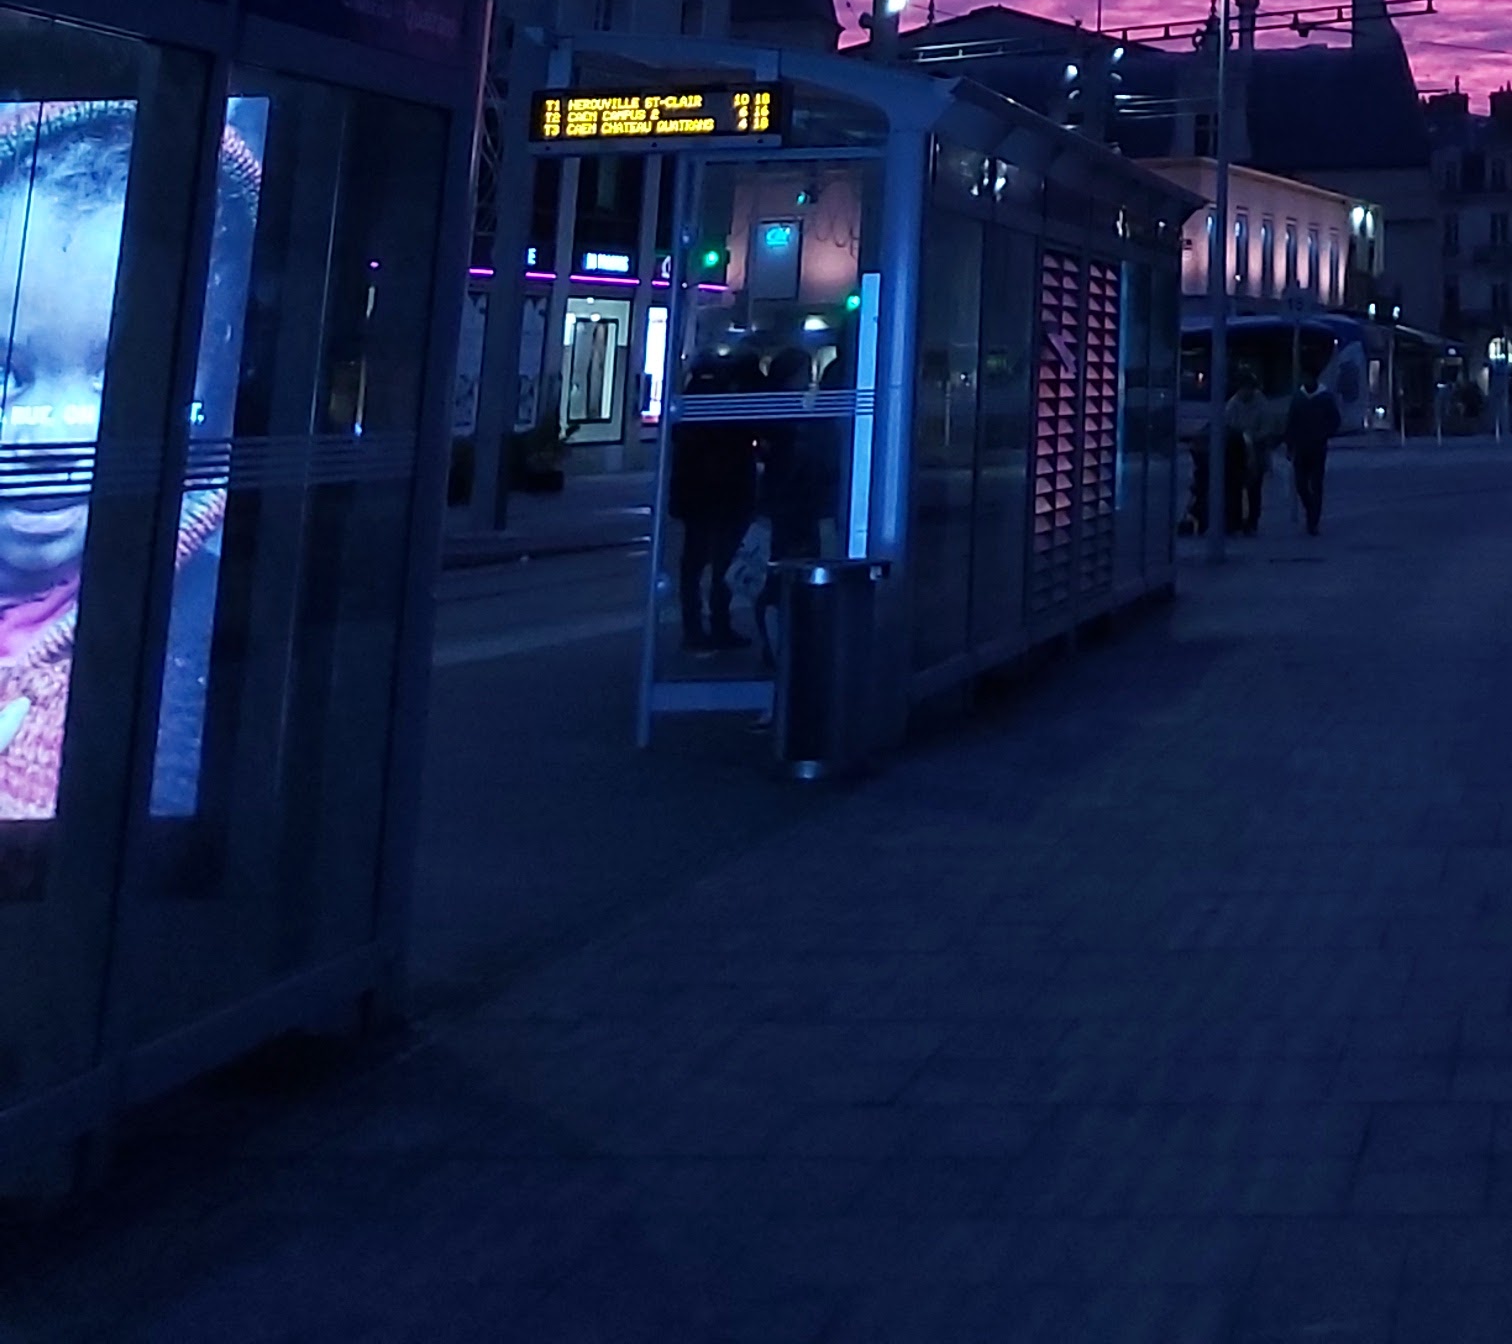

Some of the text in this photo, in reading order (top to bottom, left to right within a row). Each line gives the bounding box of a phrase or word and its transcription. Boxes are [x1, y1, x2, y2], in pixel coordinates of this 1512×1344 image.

[545, 99, 560, 111] T1
[568, 97, 640, 111] HEROUVILLE
[645, 95, 703, 109] ST-CLAIR
[734, 93, 750, 107] 10
[545, 112, 561, 123] T2
[567, 111, 598, 123] CAEN
[602, 109, 646, 121] CAMPUS
[650, 109, 660, 120] 2
[755, 105, 769, 117] 16
[543, 123, 560, 136] T3
[566, 123, 597, 135] CAEN
[601, 121, 652, 134] CHATEAU
[656, 118, 715, 133] QUATRANS
